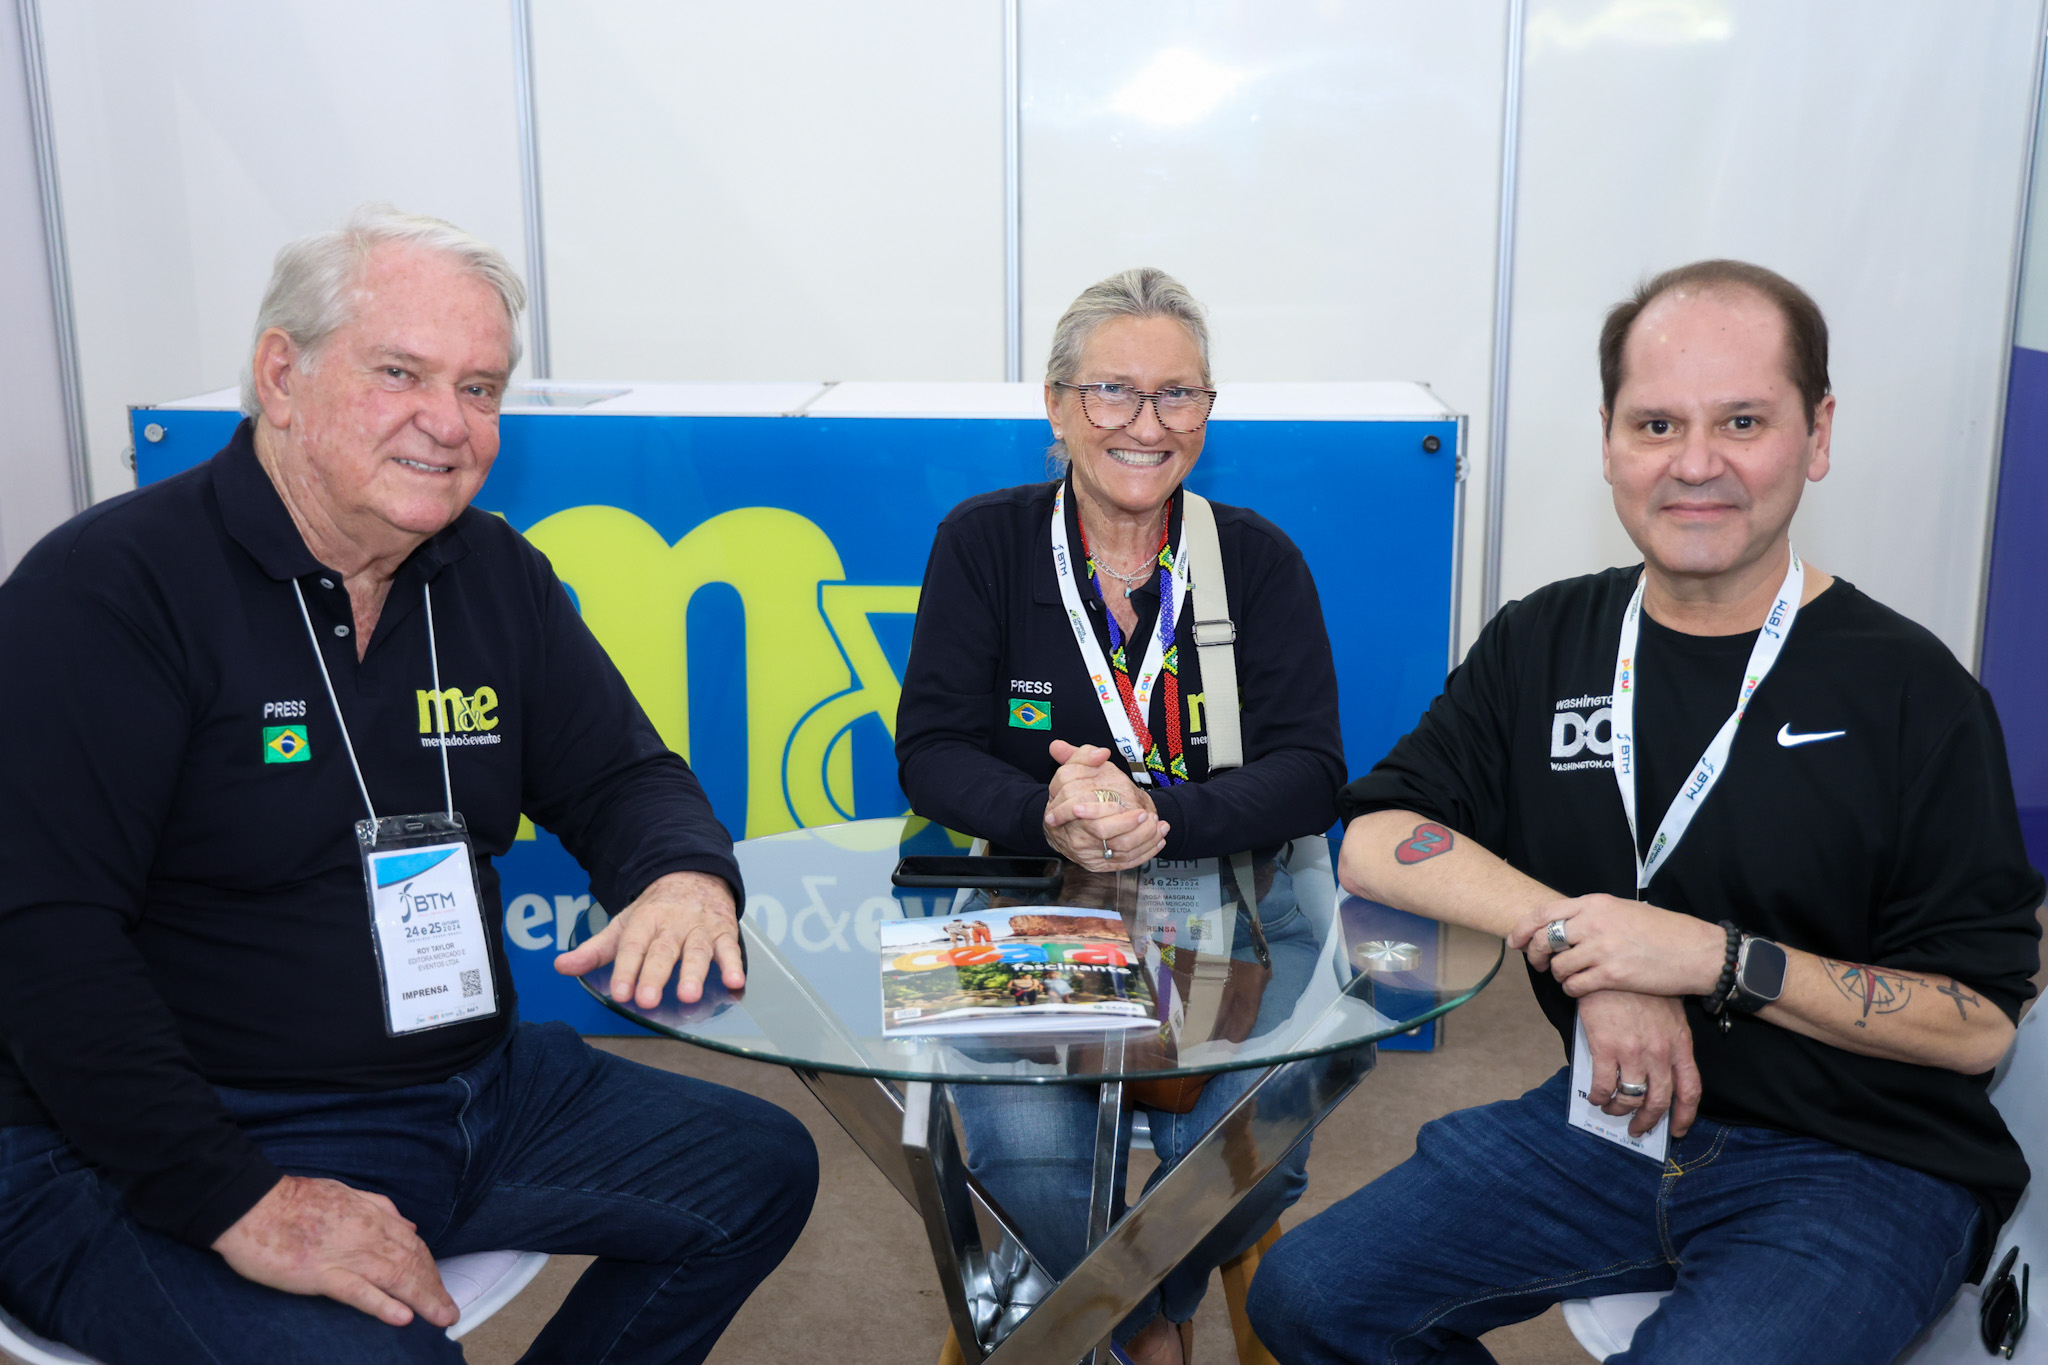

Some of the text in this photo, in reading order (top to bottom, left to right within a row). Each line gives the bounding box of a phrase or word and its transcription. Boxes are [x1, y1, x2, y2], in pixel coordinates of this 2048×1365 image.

[1057, 551, 1068, 577] BTM
[1769, 598, 1789, 627] BTM
[1010, 679, 1053, 695] PRESS
[263, 700, 307, 719] PRESS
[416, 685, 500, 734] m&e
[1621, 745, 1631, 774] BTM
[1686, 771, 1710, 801] BTM
[1165, 878, 1179, 887] 25
[414, 892, 456, 913] BTM
[405, 926, 419, 938] 24
[421, 927, 428, 936] e
[428, 922, 442, 934] 25
[443, 924, 461, 932] 2024
[417, 943, 455, 955] ROY TAYLOR
[408, 956, 434, 965] EDITORA
[433, 950, 461, 960] MERCADO
[418, 959, 460, 972] EVENTOS LTDA
[1011, 962, 1132, 976] fascinante
[402, 984, 449, 1001] IMPRENSA
